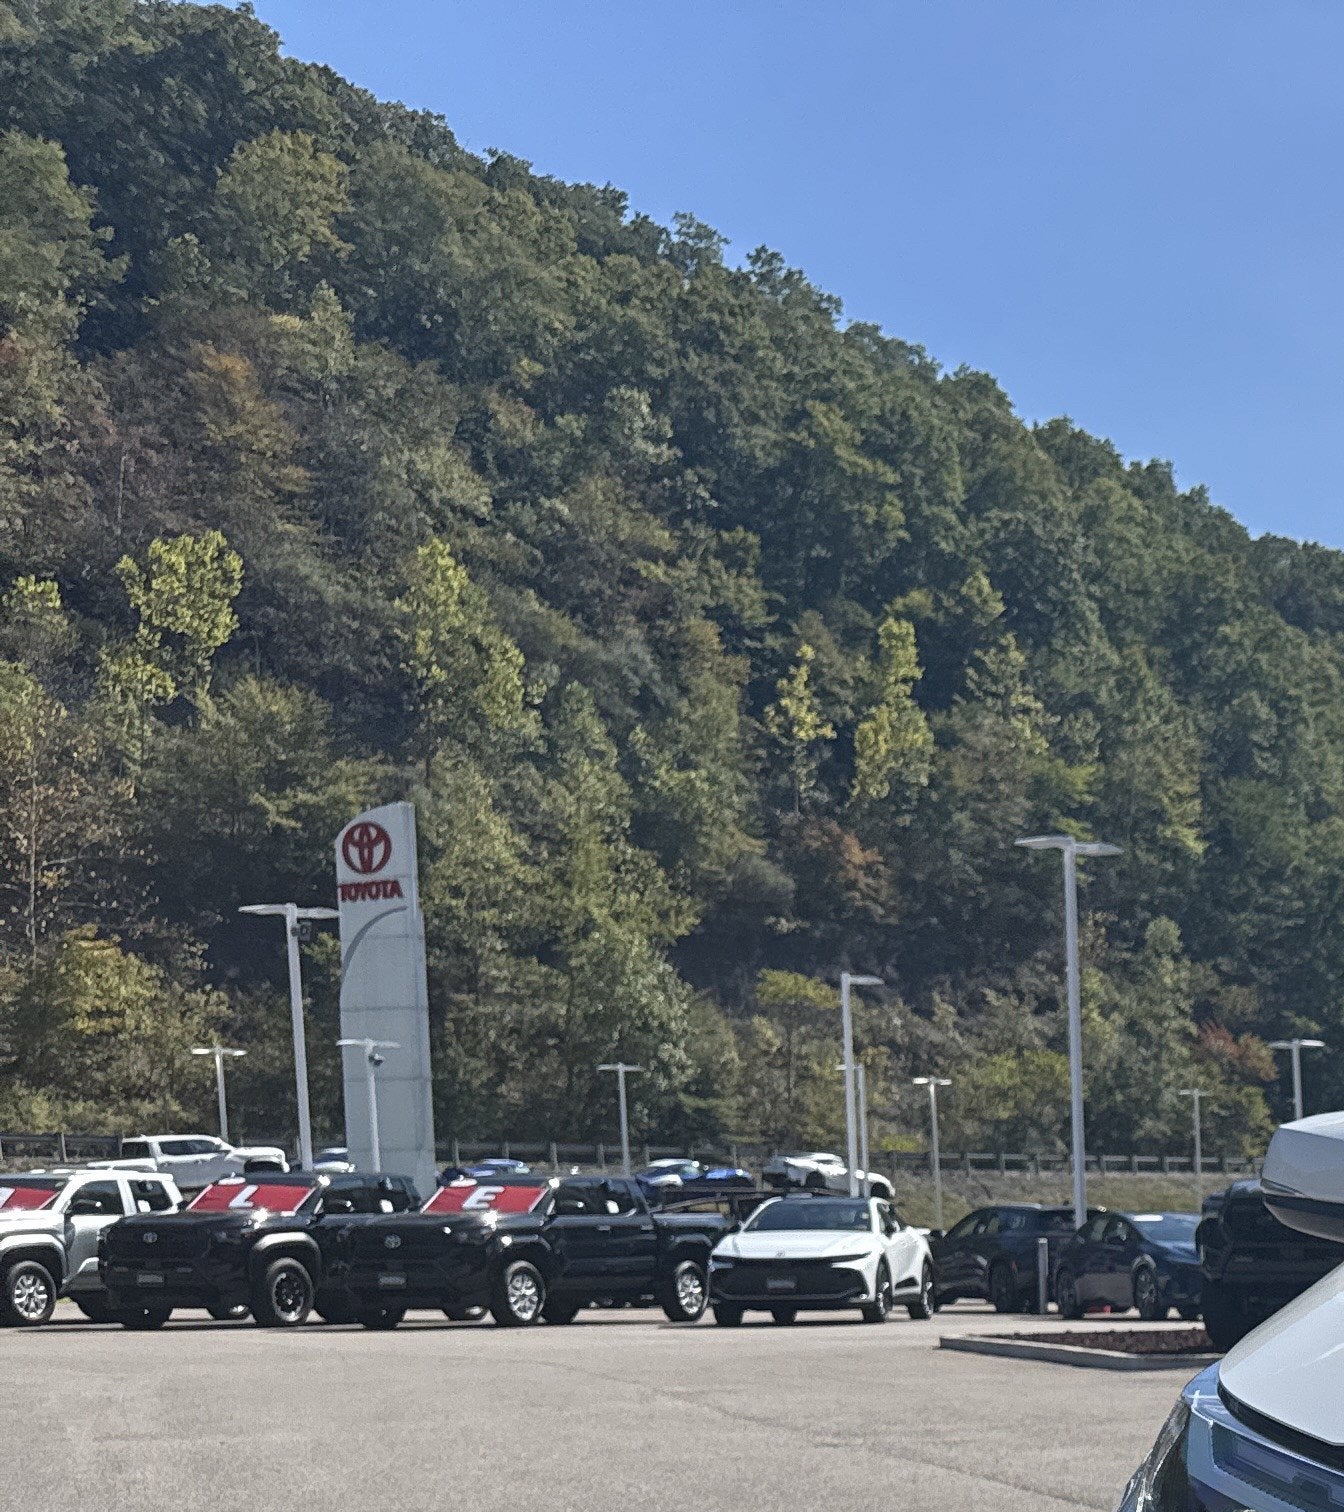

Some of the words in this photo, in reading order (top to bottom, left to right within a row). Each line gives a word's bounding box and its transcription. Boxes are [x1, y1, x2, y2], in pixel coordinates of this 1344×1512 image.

[338, 880, 403, 902] TOYOTA
[229, 1184, 259, 1208] L
[462, 1185, 505, 1209] E
